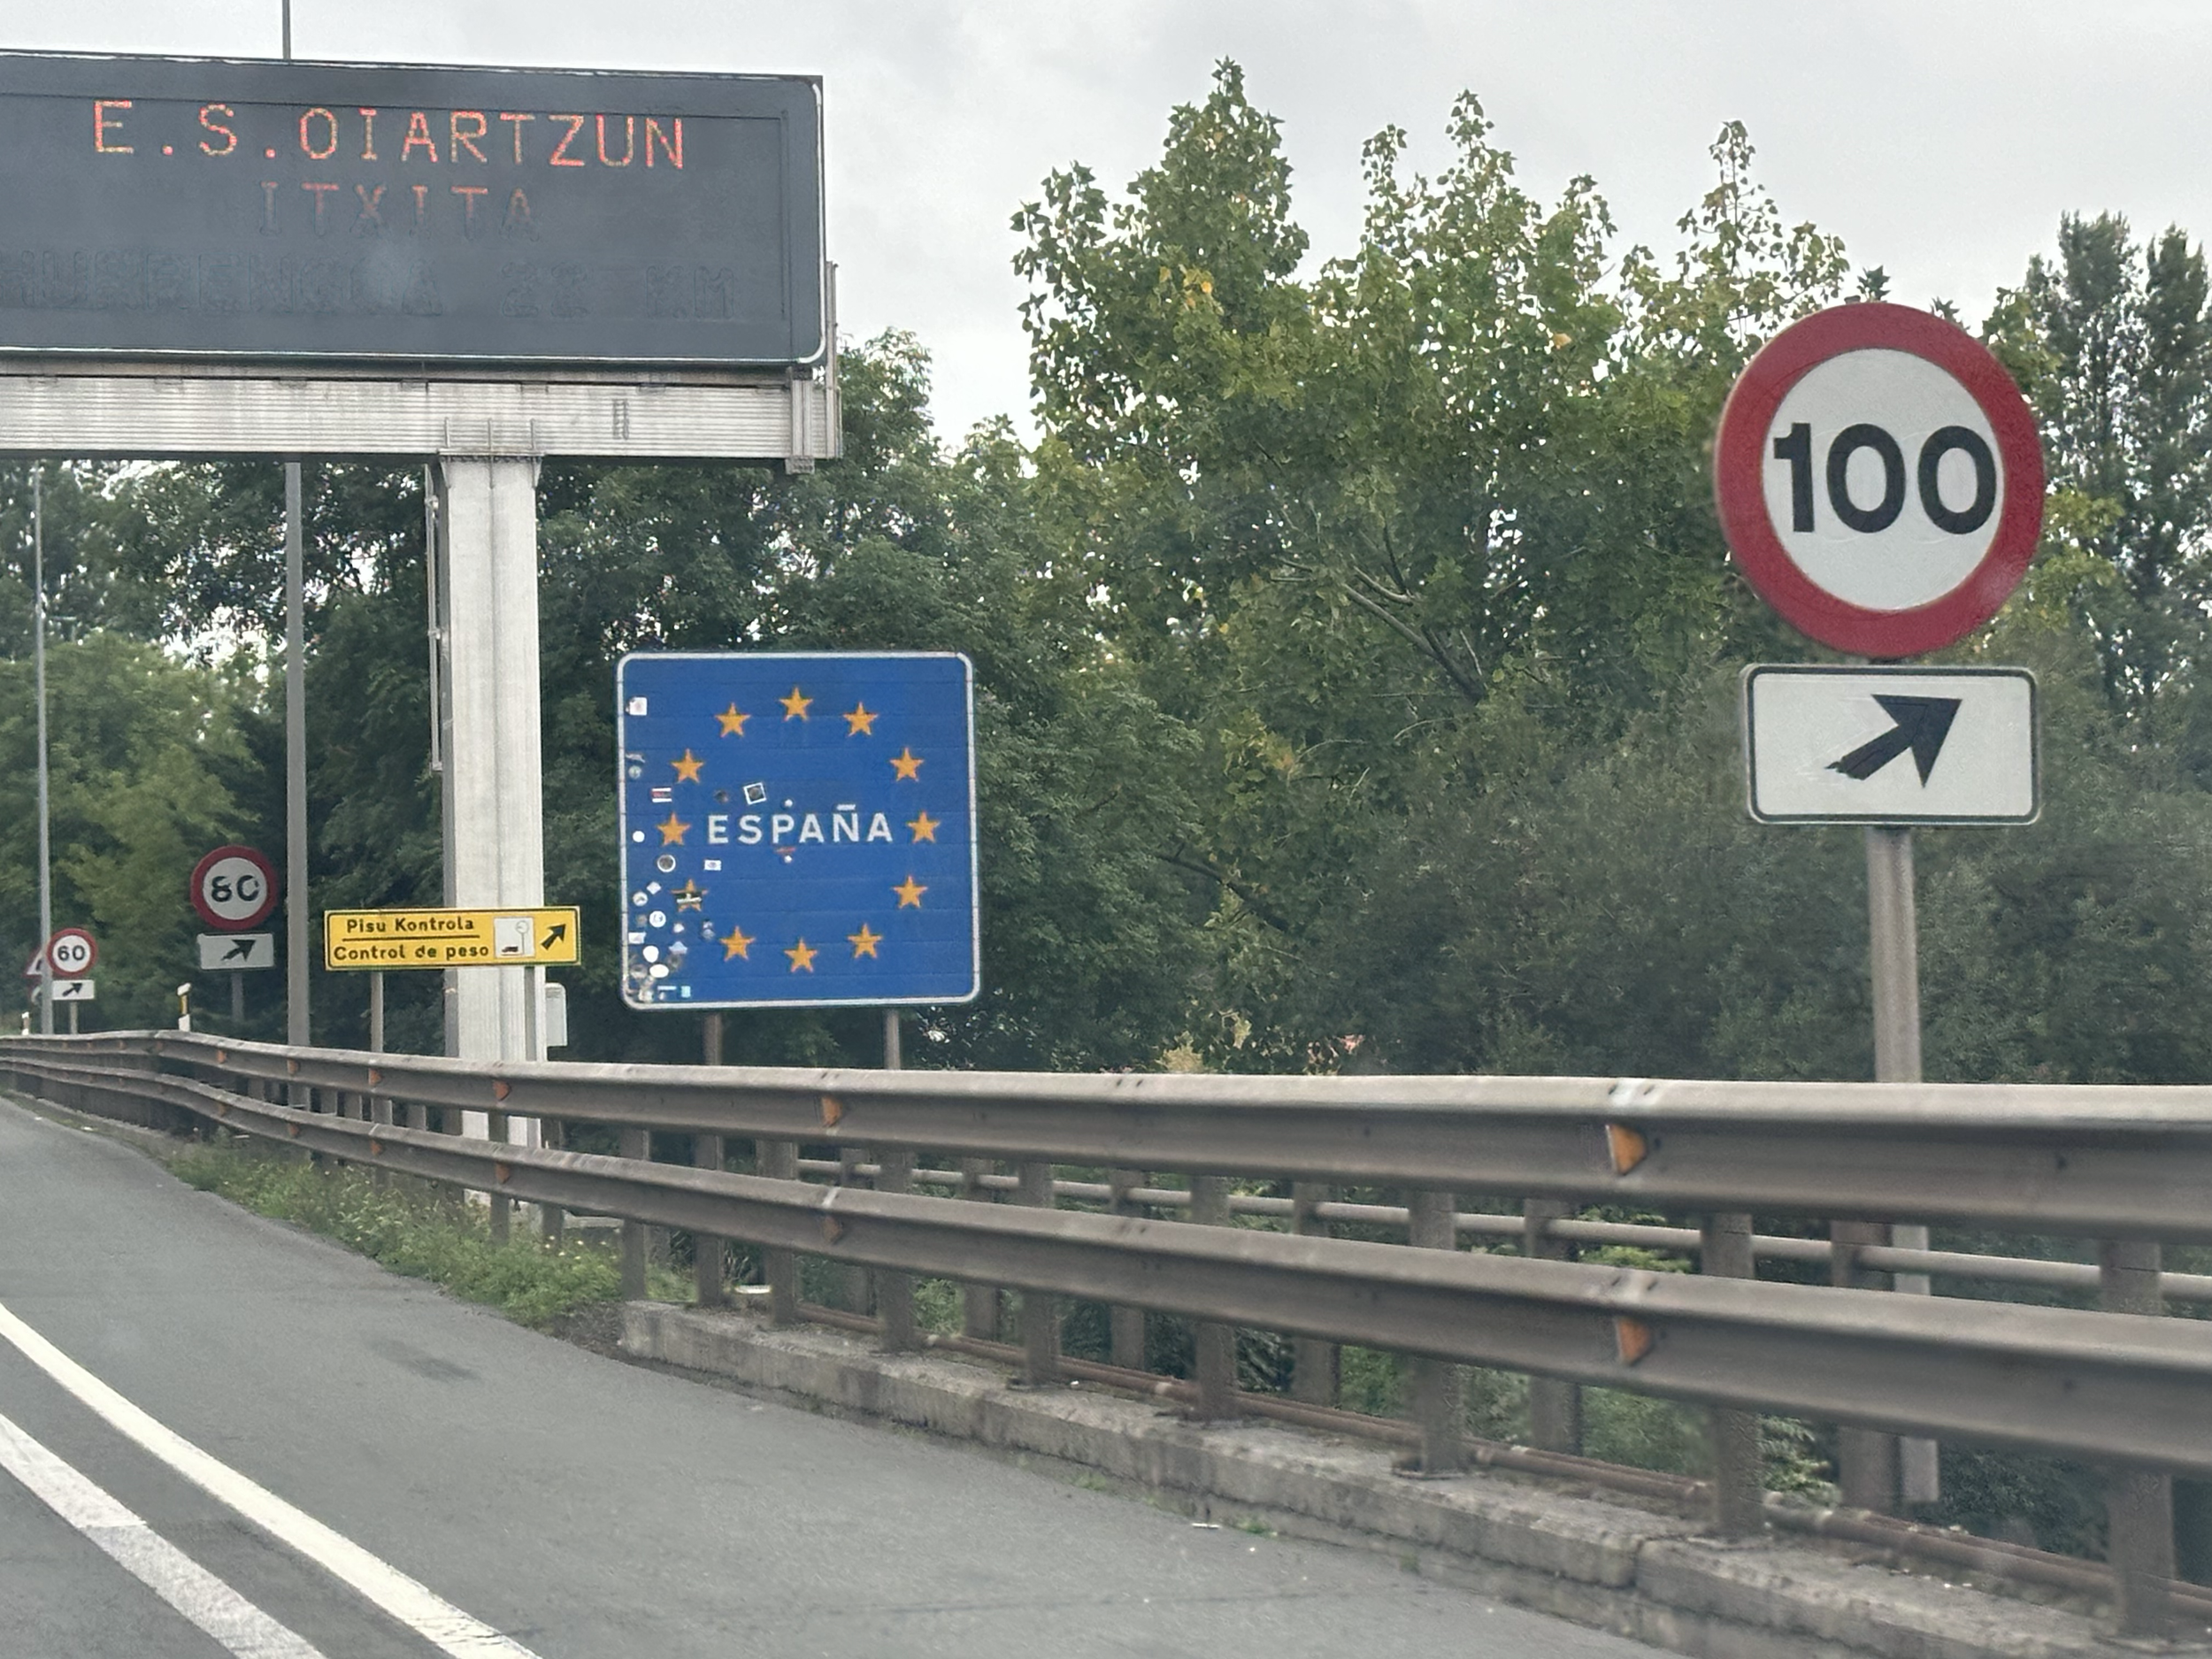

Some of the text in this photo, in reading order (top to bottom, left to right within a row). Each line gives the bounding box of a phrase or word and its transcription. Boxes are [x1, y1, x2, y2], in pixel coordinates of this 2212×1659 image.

[260, 180, 541, 242] ITXITA
[1772, 421, 1997, 534] 100
[707, 803, 894, 844] ESPAÑA
[346, 916, 475, 933] Pisu Kontrola
[57, 944, 86, 961] 60
[333, 943, 489, 961] Control de peso
